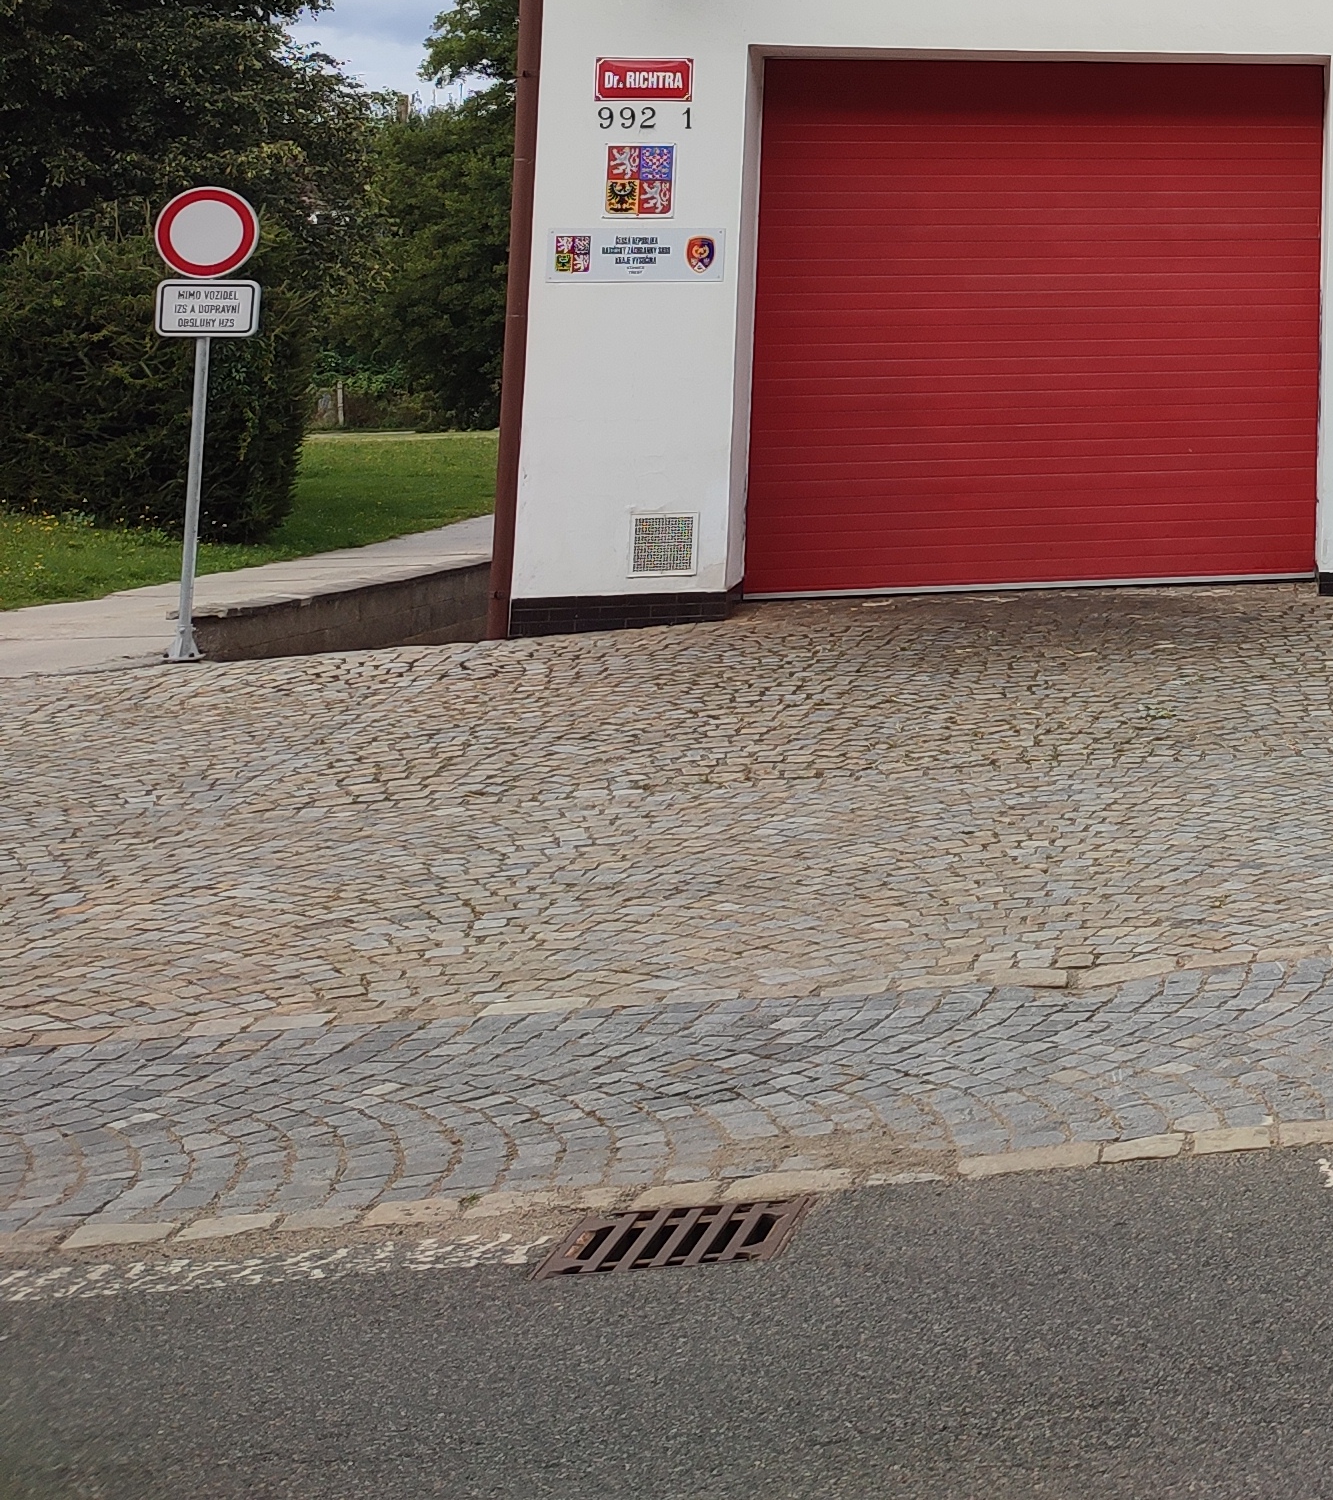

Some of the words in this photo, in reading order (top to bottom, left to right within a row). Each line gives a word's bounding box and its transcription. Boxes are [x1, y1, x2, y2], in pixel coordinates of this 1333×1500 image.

[604, 71, 623, 88] Dr.
[626, 71, 683, 89] RICHTRA
[597, 106, 656, 130] 992
[682, 107, 692, 129] 1
[177, 290, 201, 300] MIMO
[204, 290, 239, 300] VOZIDEL
[174, 303, 188, 313] IZS
[189, 303, 196, 313] A
[198, 302, 240, 314] DOPRAVNÍ
[177, 317, 216, 327] OBSLUHY
[218, 318, 235, 327] HZS
